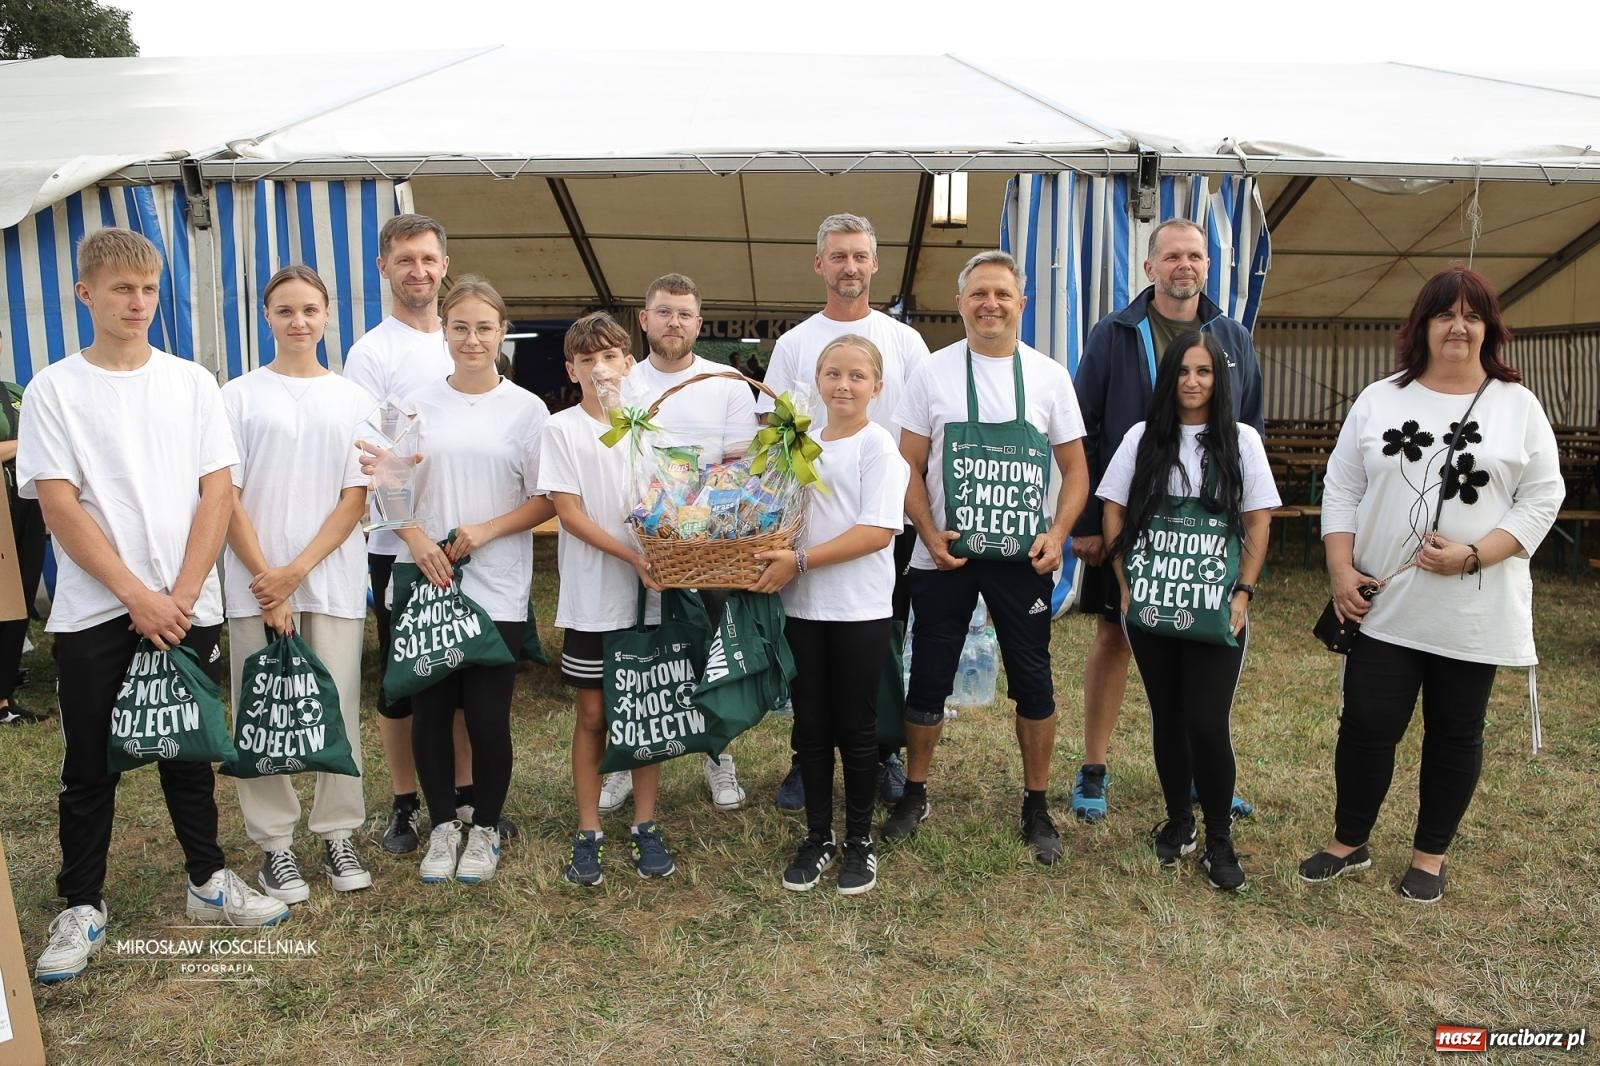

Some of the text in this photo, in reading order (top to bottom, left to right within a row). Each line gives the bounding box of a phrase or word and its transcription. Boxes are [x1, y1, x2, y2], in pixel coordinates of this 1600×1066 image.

[953, 457, 1043, 488] SPORTOWA
[975, 483, 1019, 508] MOC
[1151, 555, 1195, 581] MOC
[1131, 577, 1224, 610] OŁECTW
[418, 599, 452, 629] MOC
[394, 612, 481, 662] SOŁECTW
[111, 702, 200, 738] SOŁECTW
[635, 689, 673, 720] MOC
[239, 724, 326, 757] SOŁECTW
[611, 709, 705, 747] SOŁECTW
